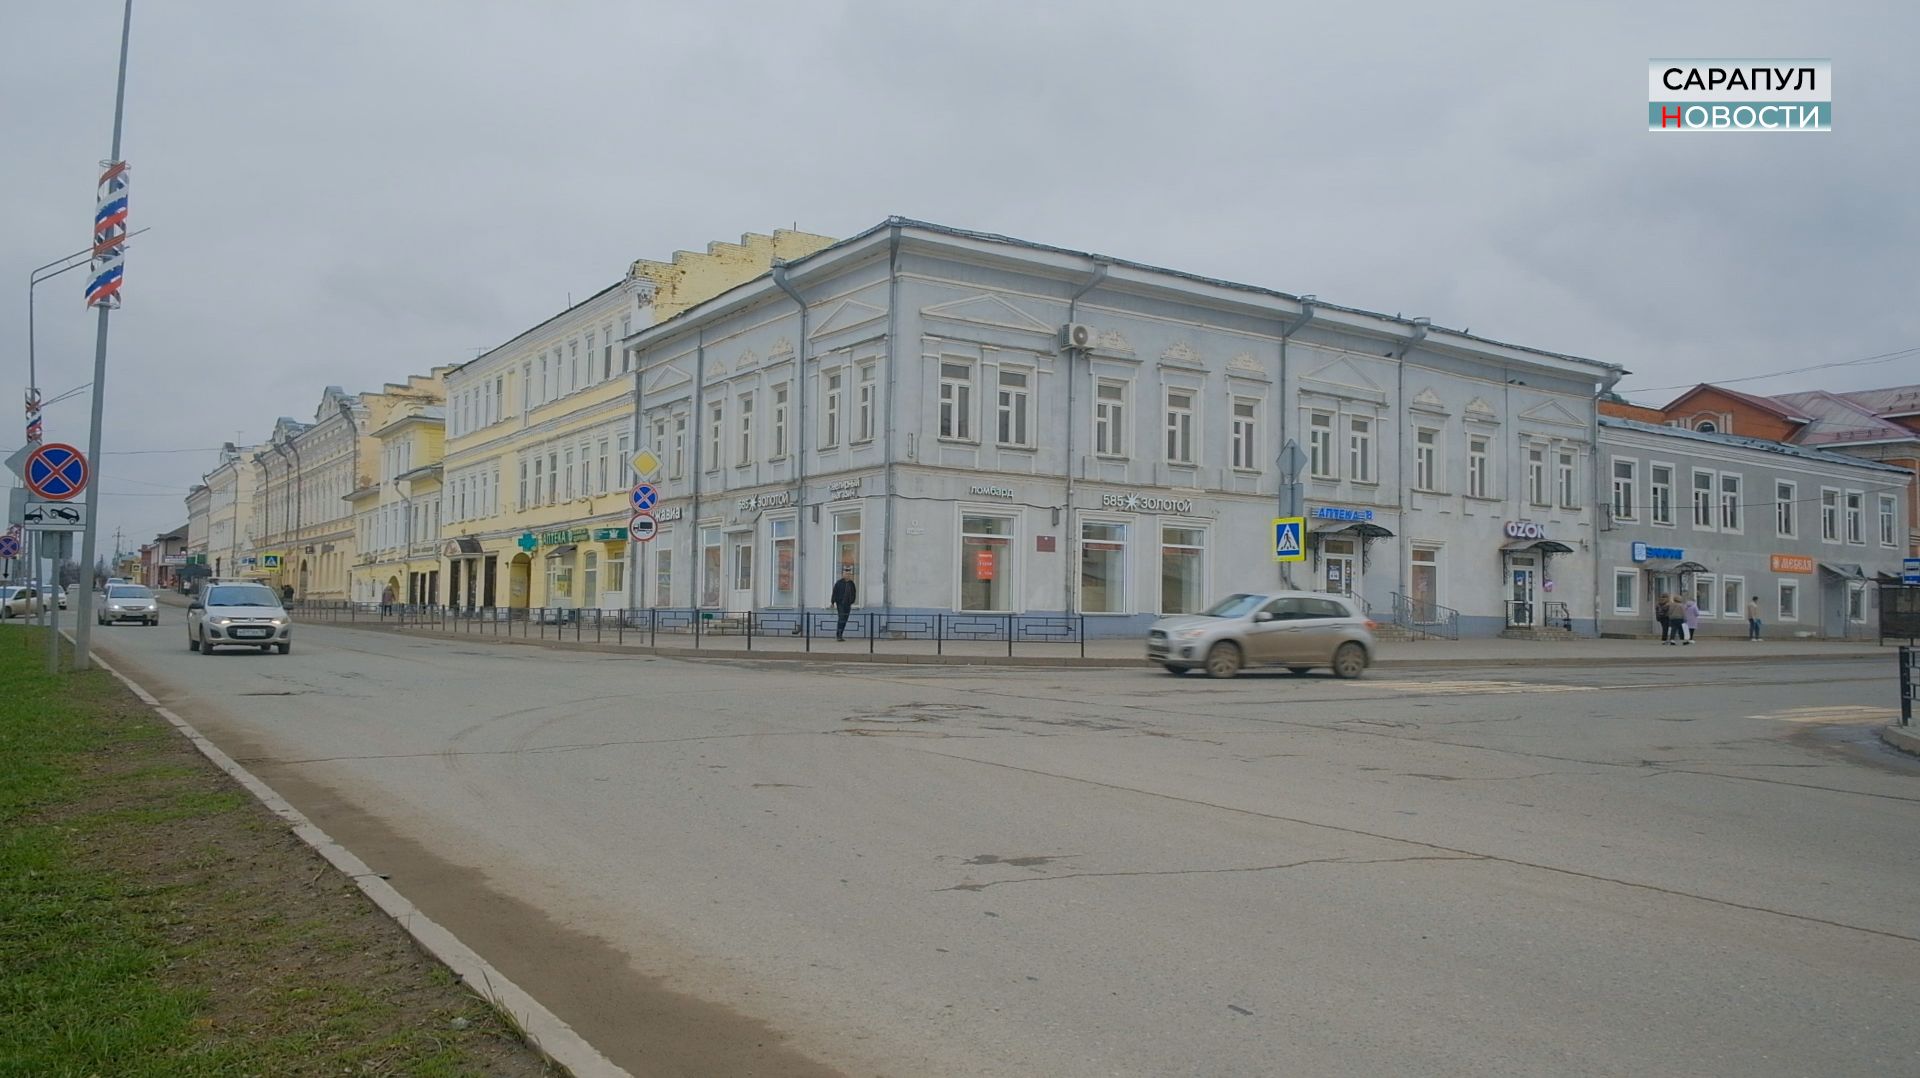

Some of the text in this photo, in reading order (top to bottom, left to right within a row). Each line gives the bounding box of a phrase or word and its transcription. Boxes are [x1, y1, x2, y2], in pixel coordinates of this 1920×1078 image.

[969, 485, 1015, 499] ломбард
[1103, 493, 1124, 507] 585
[1318, 507, 1359, 520] АПТЕКА
[543, 529, 566, 545] АПТЕКА
[1507, 522, 1546, 538] OZON
